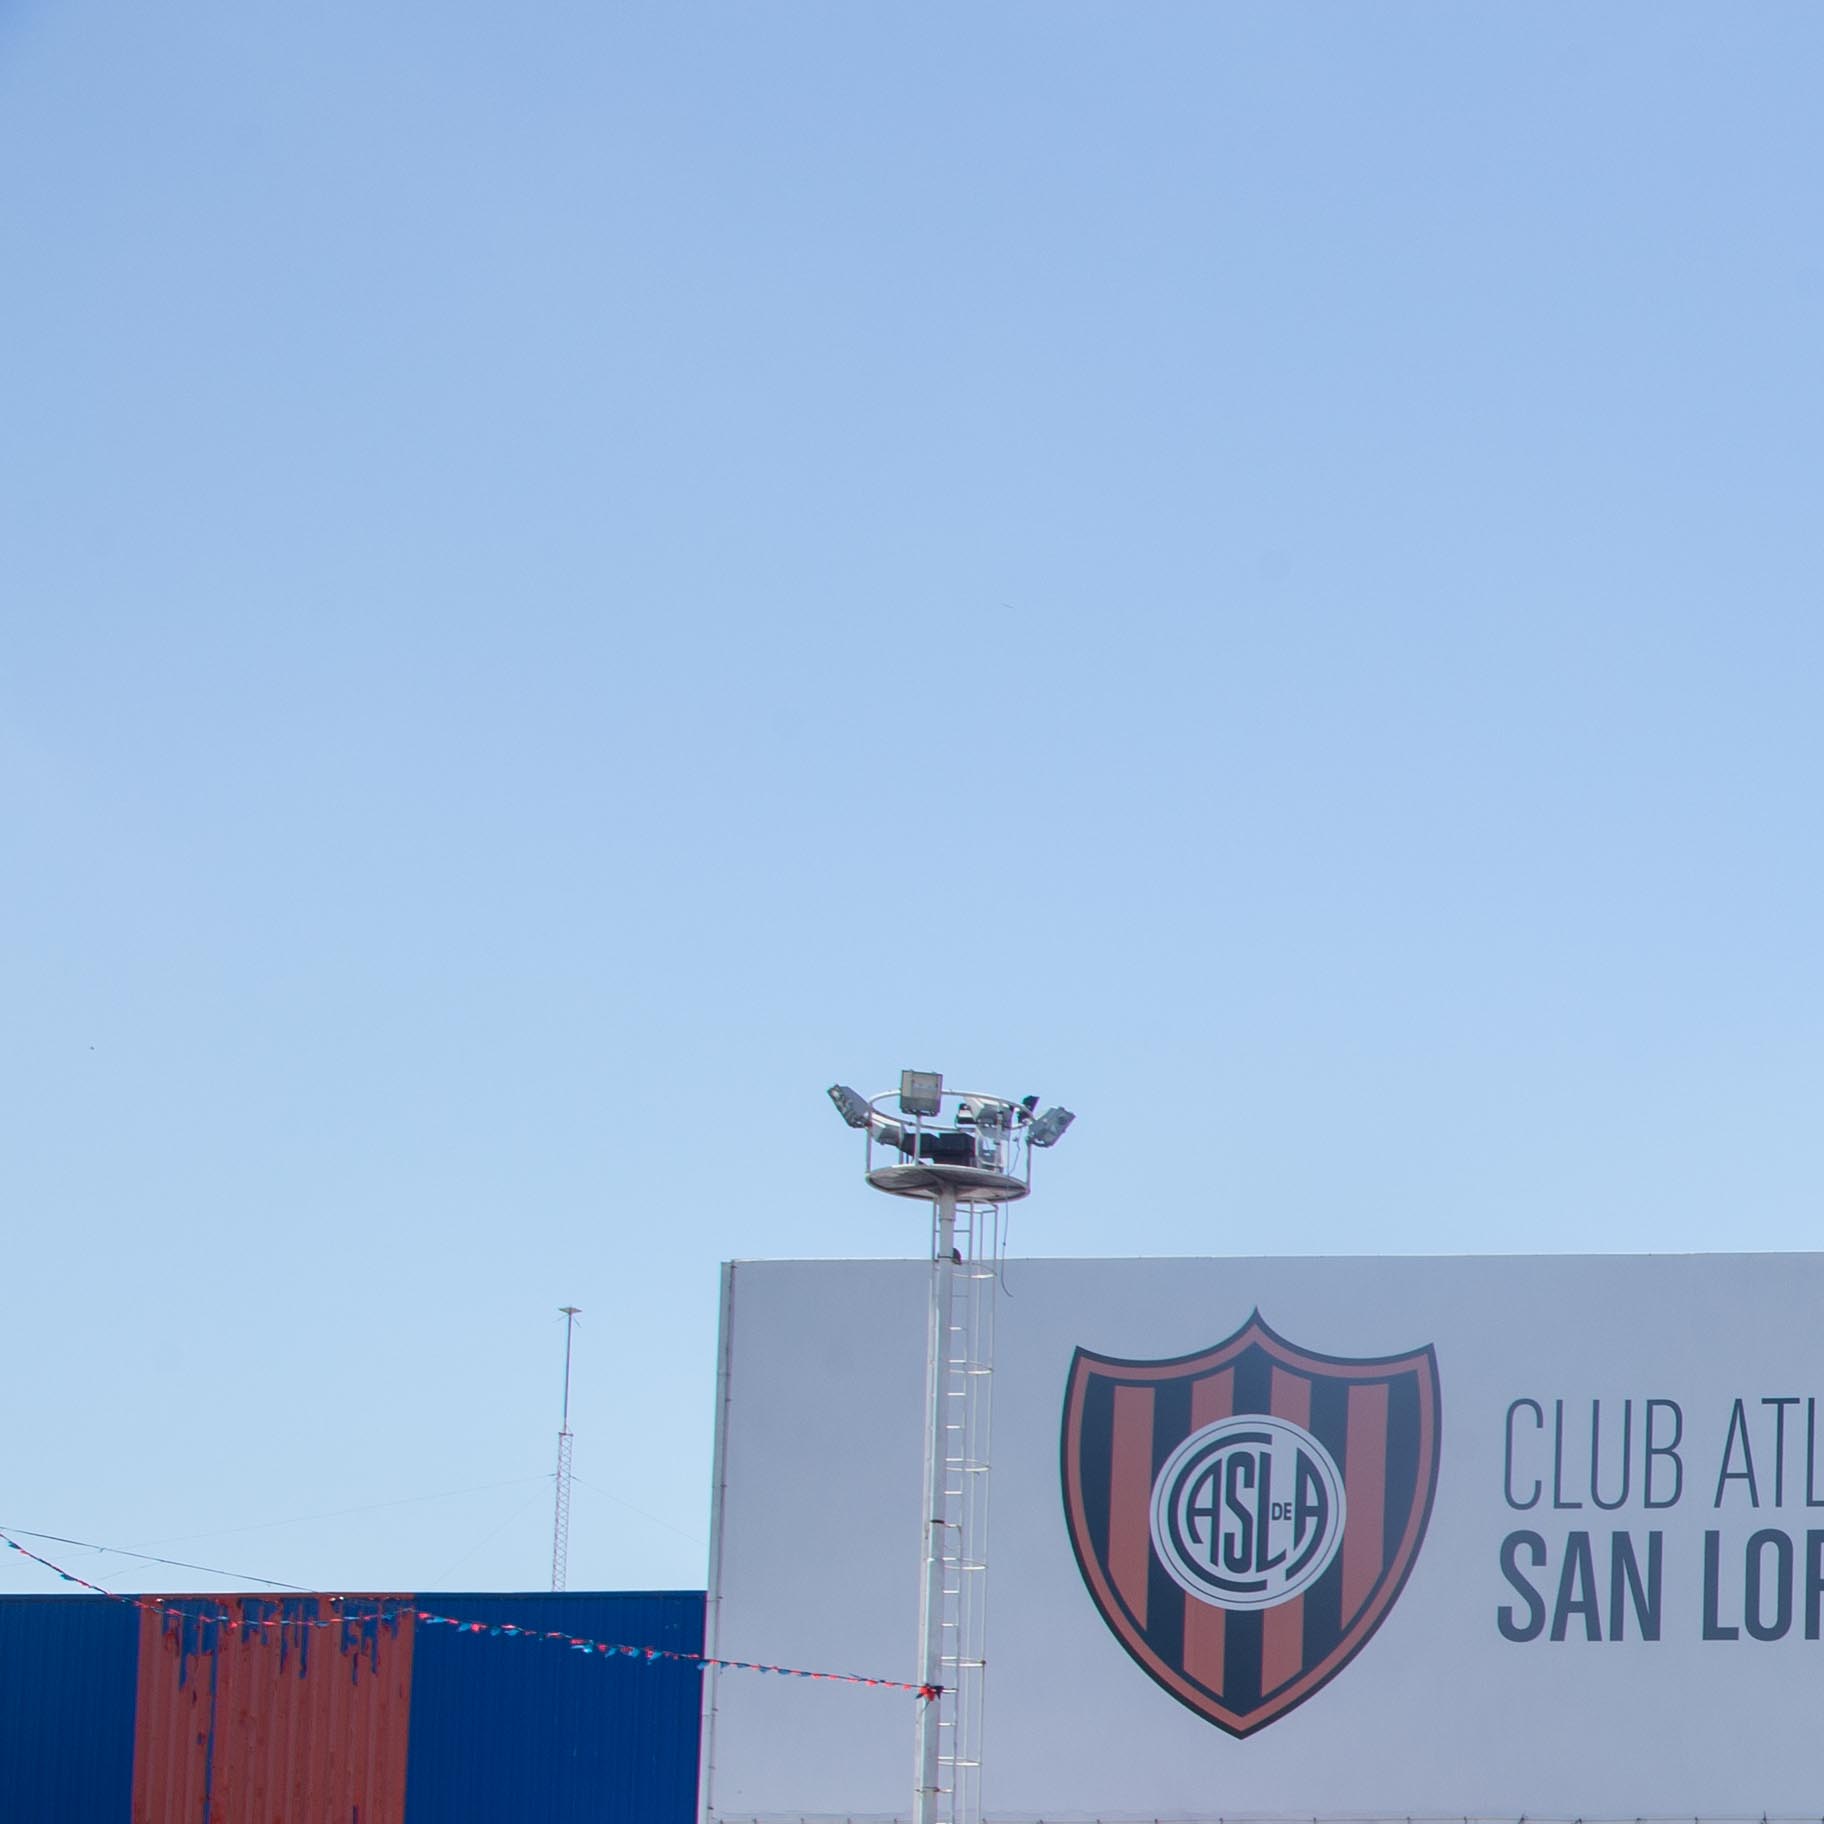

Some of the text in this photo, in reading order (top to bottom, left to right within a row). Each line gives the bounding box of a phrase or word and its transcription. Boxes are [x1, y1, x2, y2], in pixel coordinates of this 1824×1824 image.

[1504, 1398, 1683, 1510] CLUB
[1271, 1502, 1293, 1521] DE
[1497, 1529, 1663, 1642] SAN
